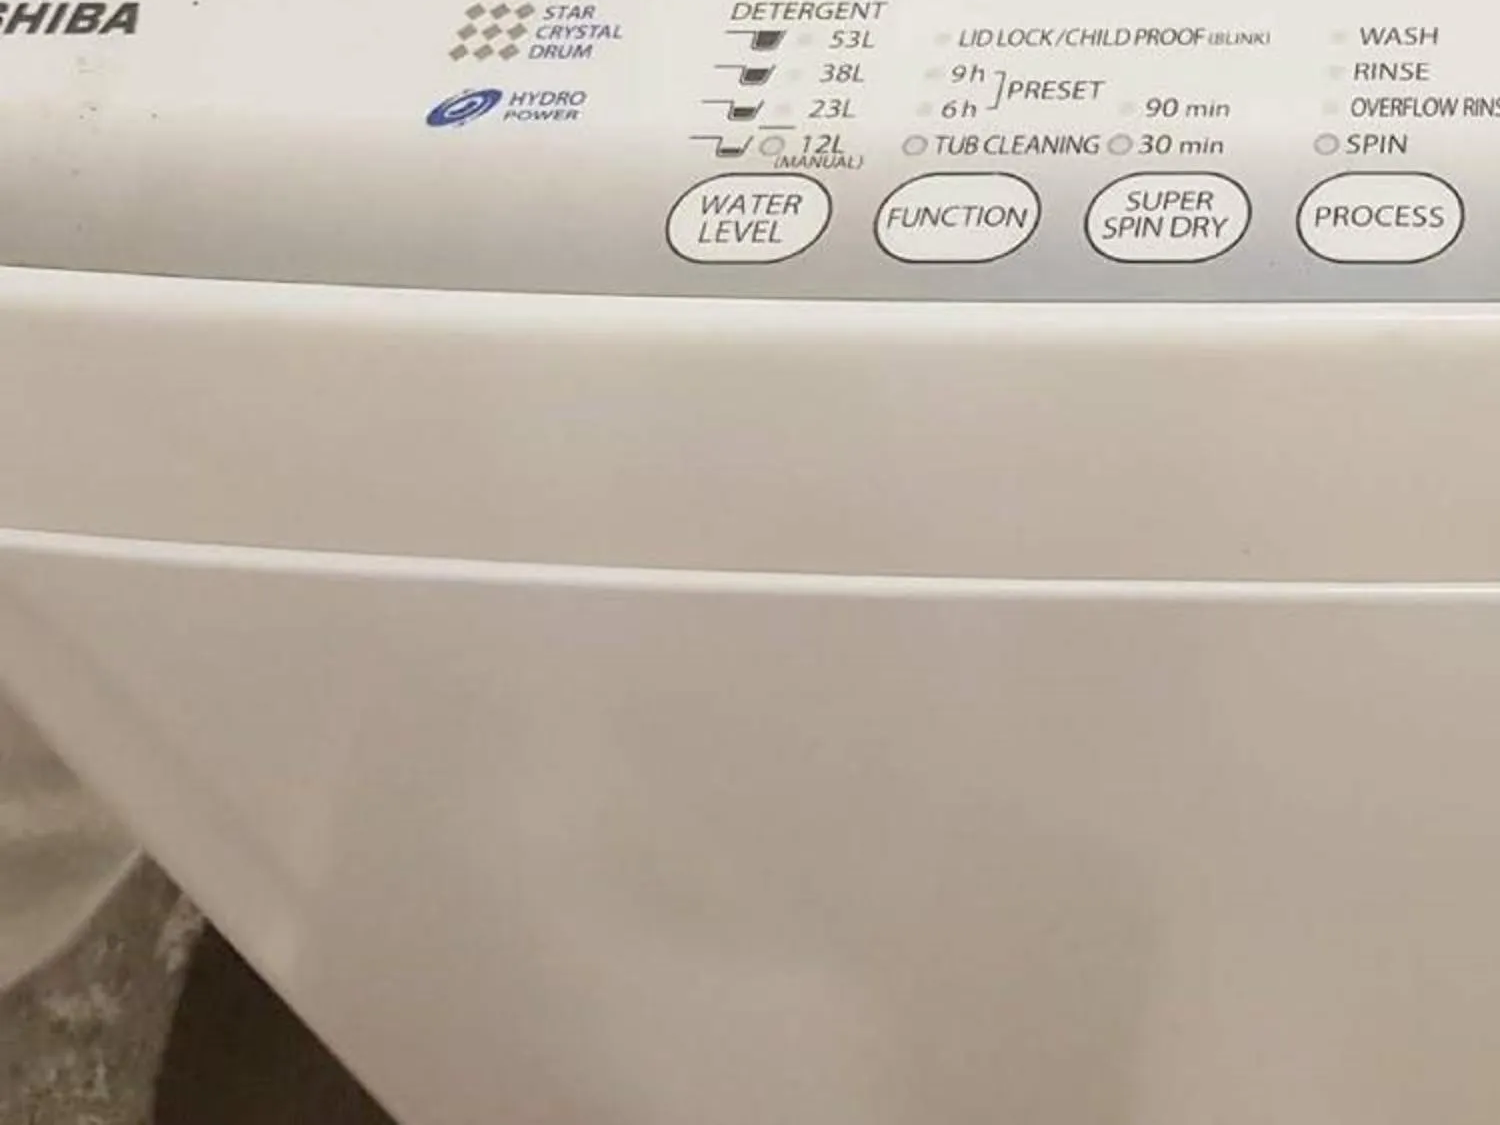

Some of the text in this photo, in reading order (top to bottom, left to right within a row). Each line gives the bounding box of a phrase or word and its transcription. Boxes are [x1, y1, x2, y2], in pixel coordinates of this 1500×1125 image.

[0, 2, 140, 35] HIBA
[542, 5, 596, 20] STAR
[730, 1, 888, 21] DETERGENT
[534, 25, 624, 40] CRYSTAL
[828, 30, 876, 49] 53L
[958, 28, 996, 48] LID
[1133, 26, 1206, 46] PROOF
[1207, 30, 1271, 46] (BLINK)
[1359, 26, 1439, 46] WASH
[528, 44, 593, 60] DRUM
[818, 64, 865, 84] 38L
[1353, 62, 1431, 81] RINSE
[508, 90, 587, 107] HYDRO
[1007, 81, 1106, 101] PRESET
[503, 108, 581, 121] POWER
[808, 99, 856, 118] 23L
[1144, 97, 1231, 118] 90 min
[1350, 97, 1459, 118] OVERFLOW
[801, 134, 844, 155] 12L
[935, 134, 1101, 156] TUB CLEANING
[1138, 135, 1224, 155] 30 min
[1345, 134, 1409, 155] SPIN
[774, 154, 864, 170] (MANUAL)
[700, 194, 803, 215] WATER
[1125, 190, 1214, 211] SUPER
[886, 205, 1029, 229] FUNCTION
[1314, 205, 1445, 228] PROCESS
[698, 221, 783, 244] LEVEL
[1102, 216, 1229, 240] SPIN DRY
